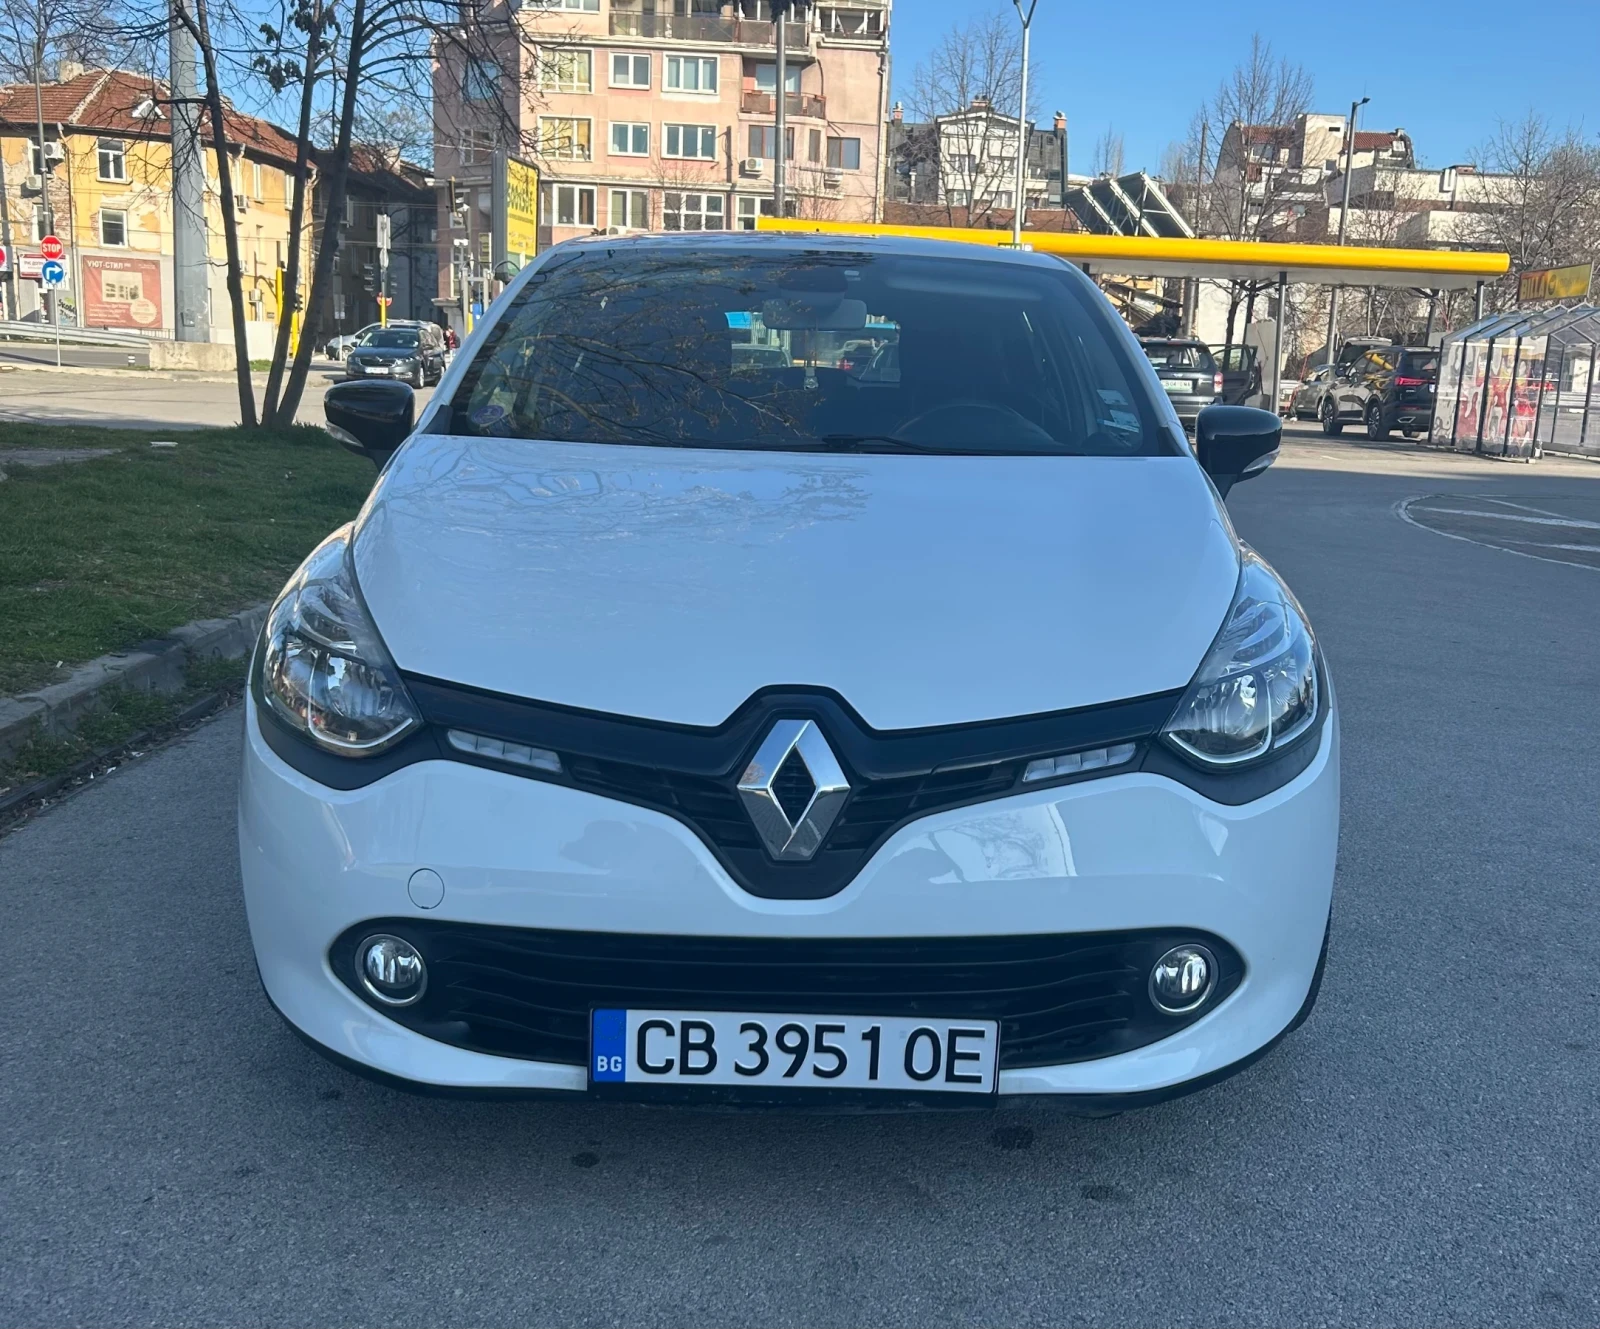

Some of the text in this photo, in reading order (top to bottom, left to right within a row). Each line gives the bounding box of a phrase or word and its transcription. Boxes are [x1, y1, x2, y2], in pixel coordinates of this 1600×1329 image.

[42, 243, 61, 253] STOP
[1520, 275, 1545, 300] BILLA
[636, 1019, 986, 1084] CB 3951 OE
[597, 1056, 622, 1072] BG
